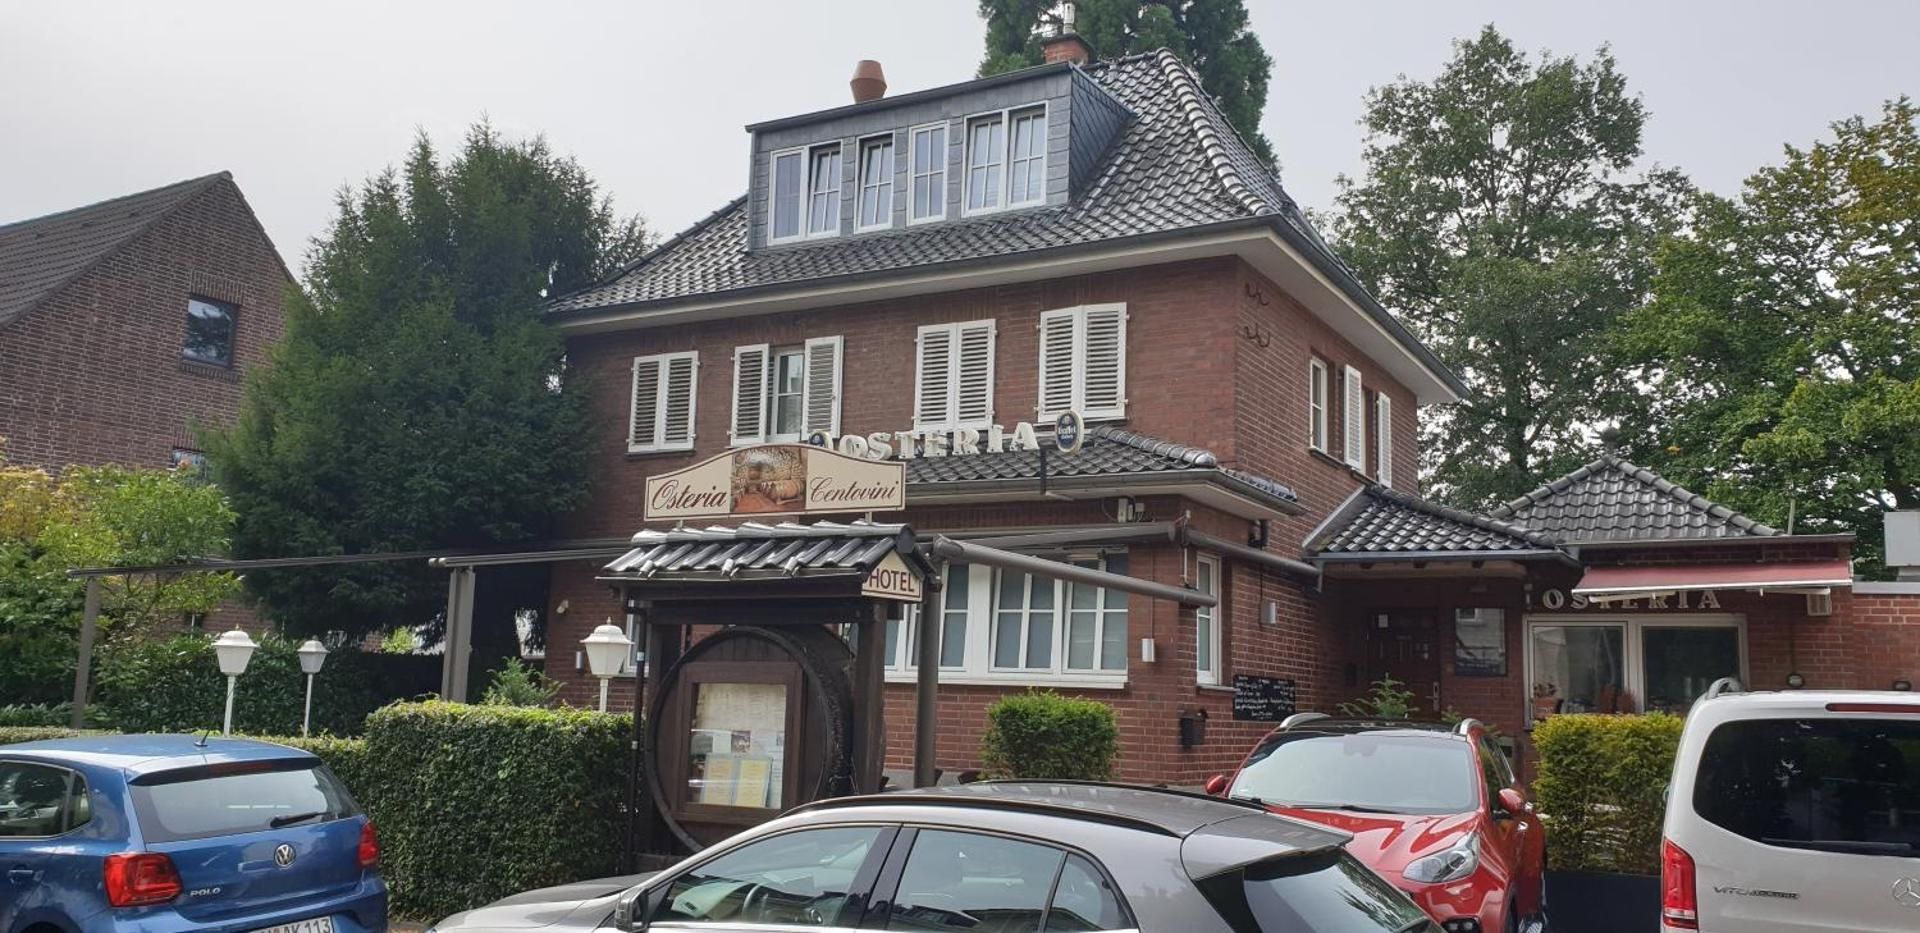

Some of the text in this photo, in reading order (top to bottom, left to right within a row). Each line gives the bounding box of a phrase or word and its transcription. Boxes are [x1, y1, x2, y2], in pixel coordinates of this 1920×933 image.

[839, 421, 1040, 460] OSTERIA
[651, 477, 899, 510] Osteria Centovini
[869, 568, 914, 592] HOTEL
[190, 887, 221, 897] POLO
